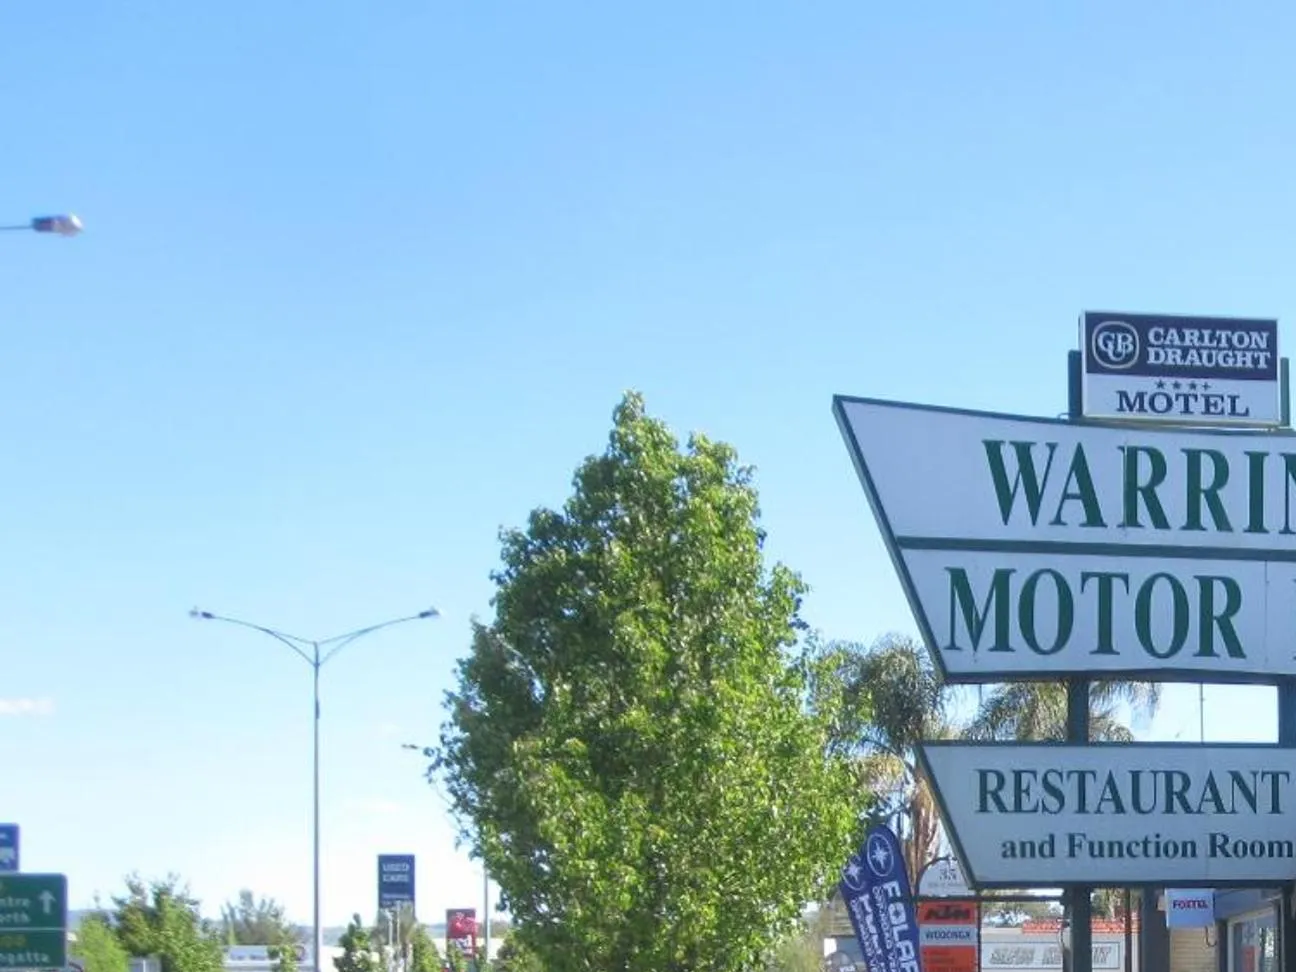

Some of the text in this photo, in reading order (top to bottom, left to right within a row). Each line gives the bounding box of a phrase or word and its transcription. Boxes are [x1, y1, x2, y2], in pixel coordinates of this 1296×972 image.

[1147, 327, 1270, 349] CARLTON
[1146, 347, 1271, 369] DRAUGHT
[1116, 390, 1249, 417] MOTEL
[943, 566, 1247, 660] MOTOR
[974, 768, 1290, 815] RESTAURANT
[1001, 832, 1294, 859] and Function Room
